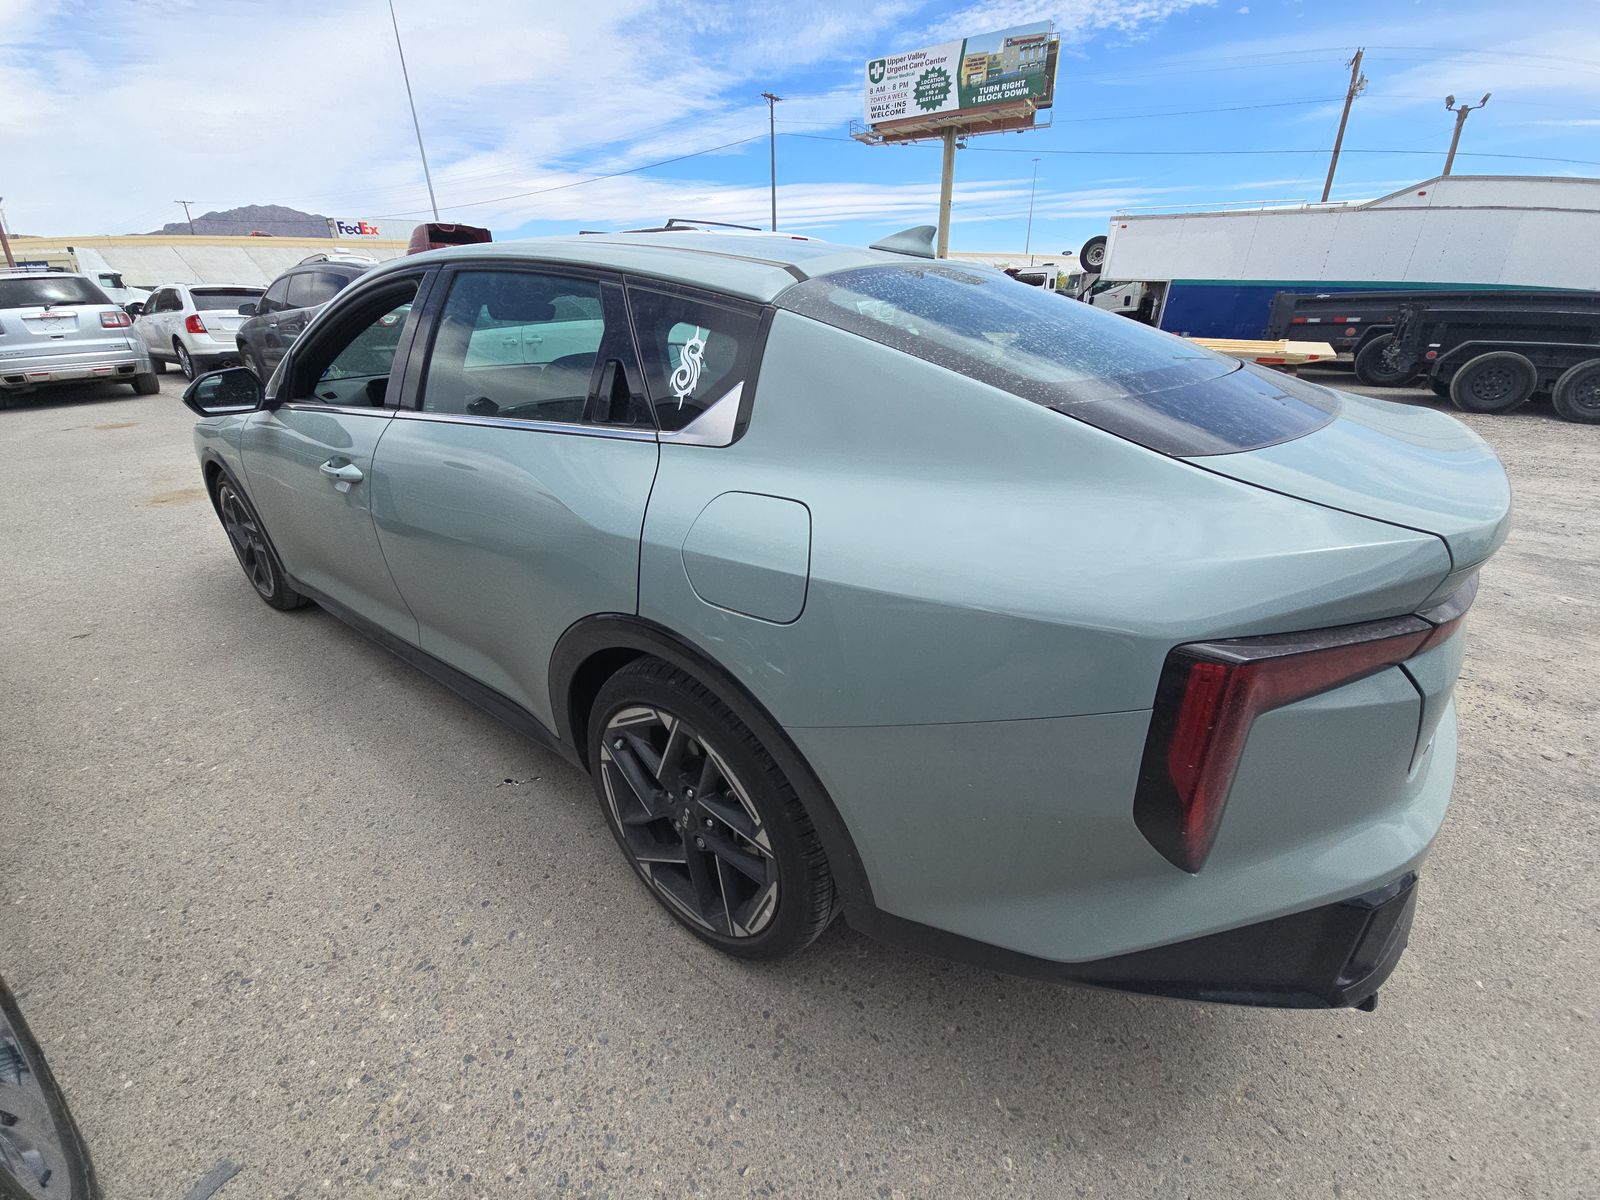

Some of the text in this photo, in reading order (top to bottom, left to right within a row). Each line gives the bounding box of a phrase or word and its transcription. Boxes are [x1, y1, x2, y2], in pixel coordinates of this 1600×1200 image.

[887, 52, 928, 66] Upper Valley
[887, 56, 948, 74] Urgent Care Center
[920, 76, 945, 85] LOCATION
[979, 80, 1026, 94] TURN RIGHT
[869, 87, 874, 95] 8
[876, 85, 886, 94] AM
[899, 81, 909, 89] PM
[977, 92, 1003, 102] BLOCK
[1004, 87, 1029, 98] DOWN
[870, 108, 906, 119] WELCOME
[336, 221, 380, 235] FedEx
